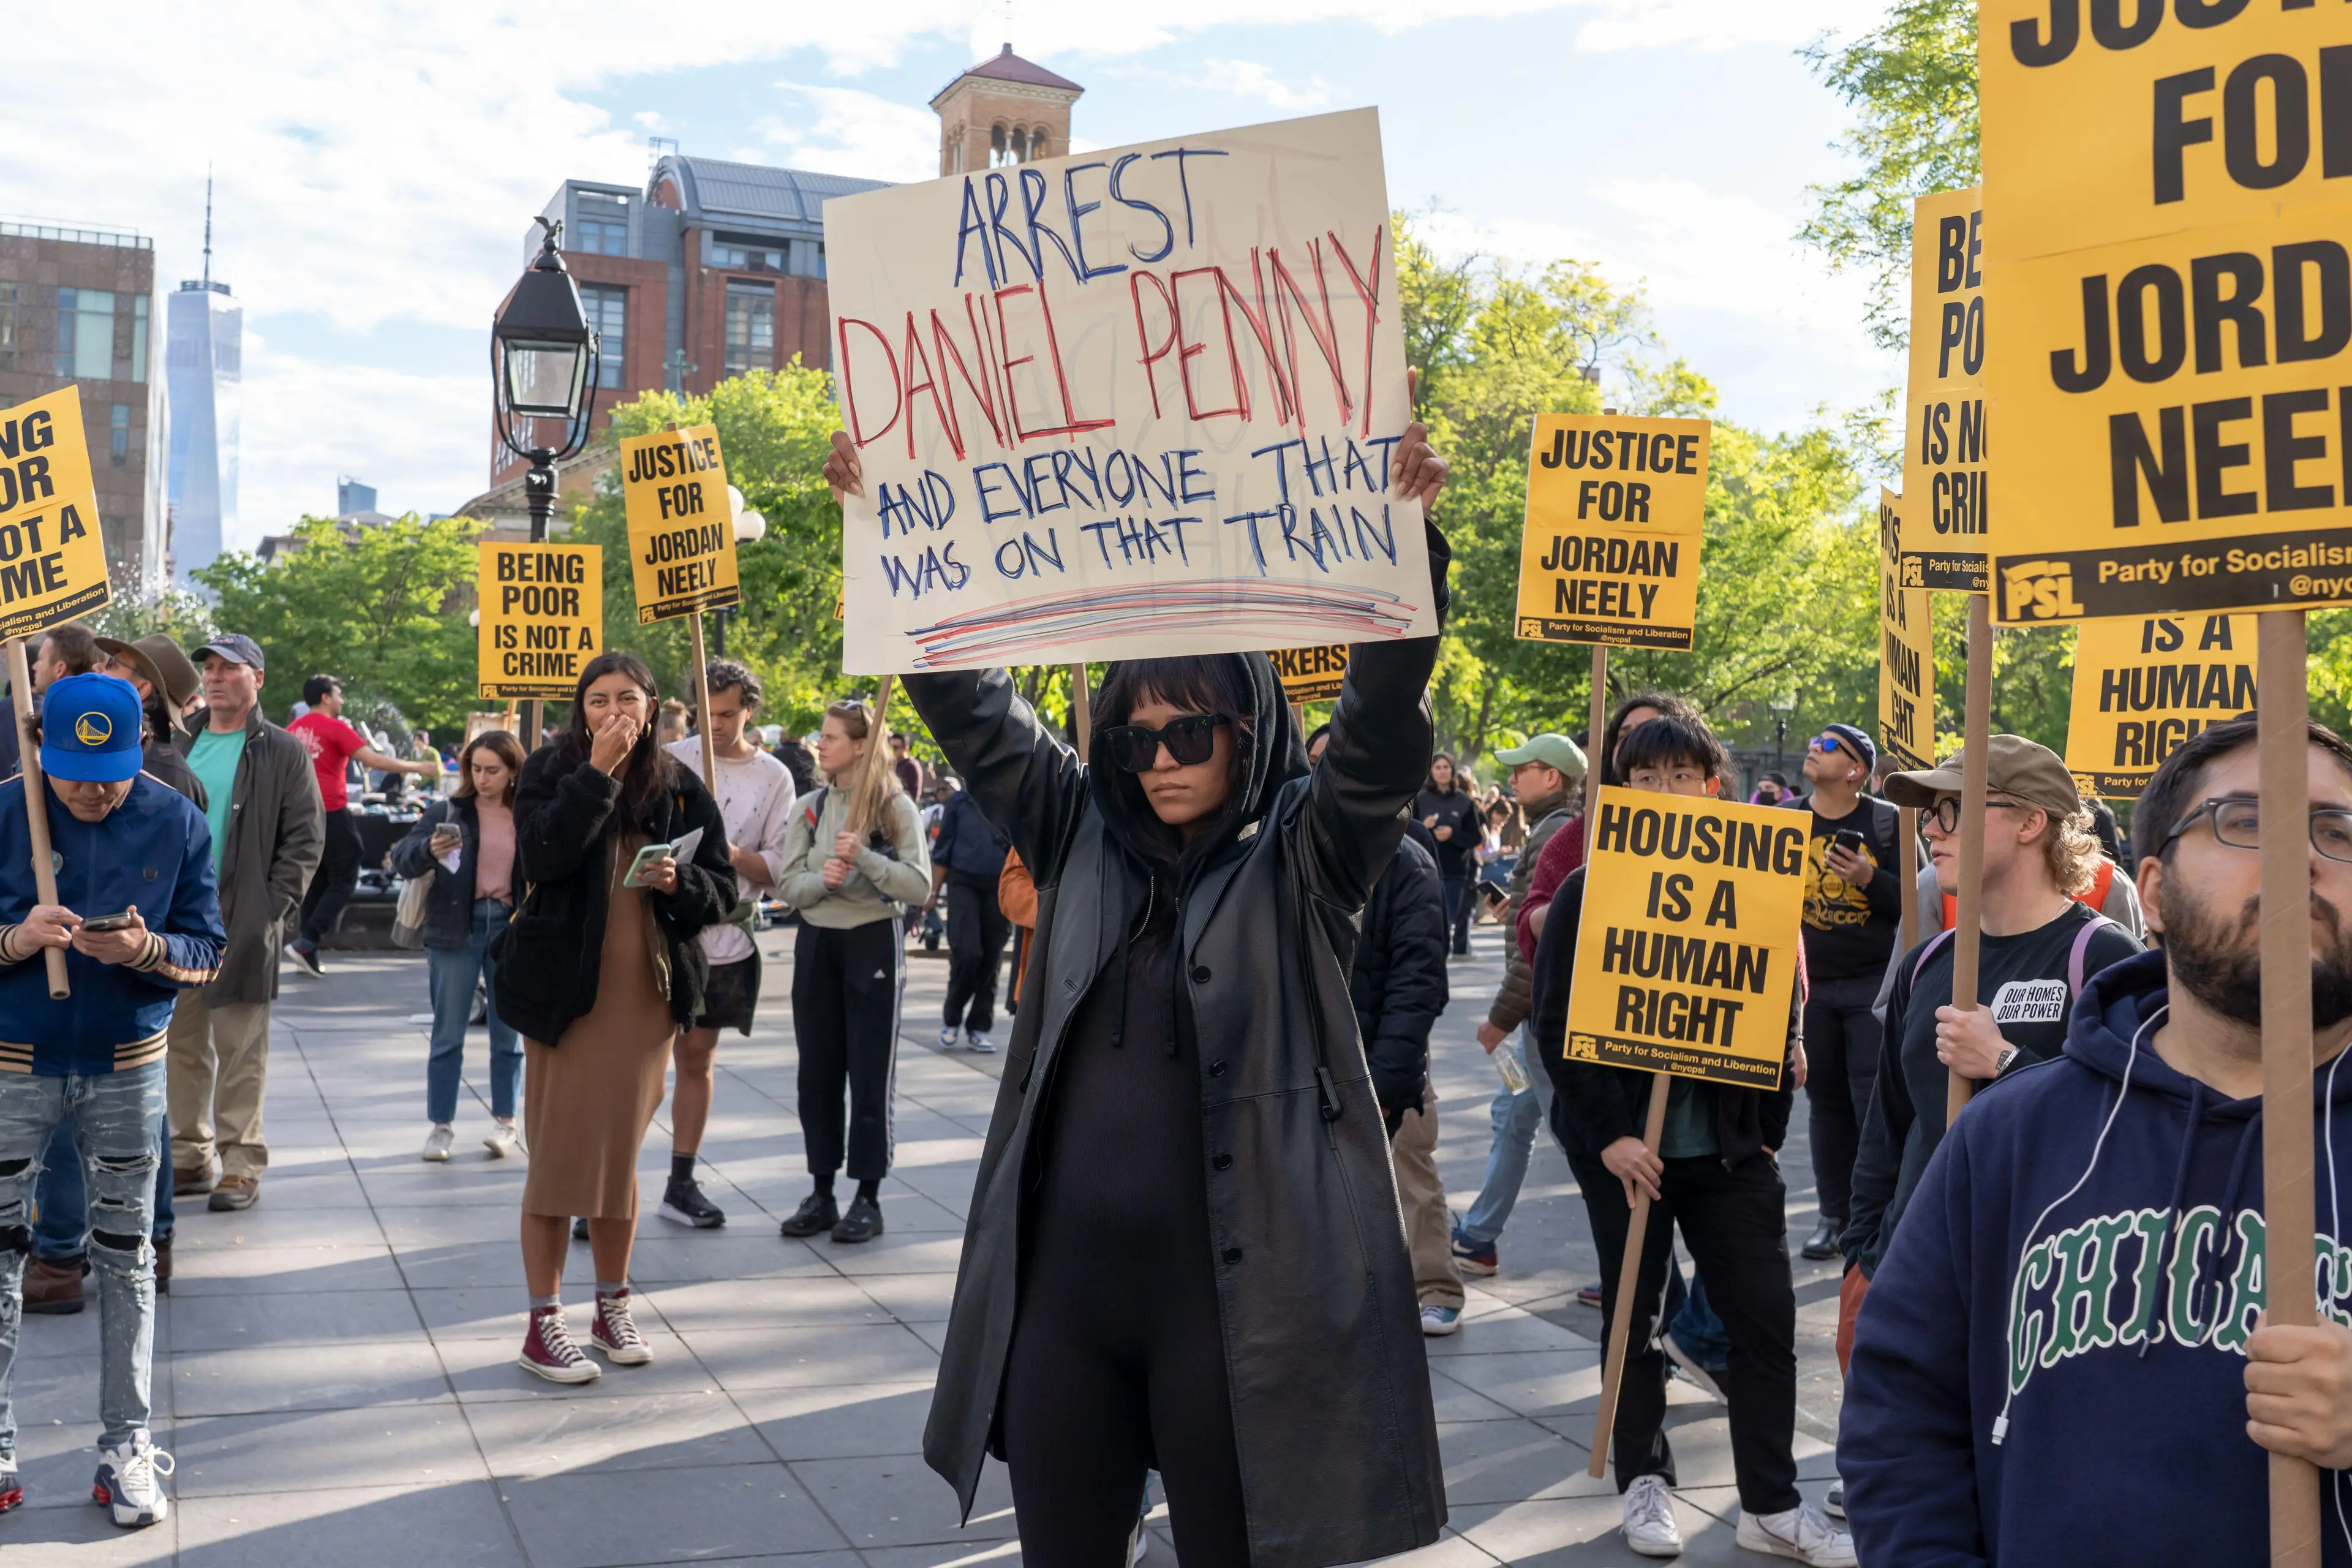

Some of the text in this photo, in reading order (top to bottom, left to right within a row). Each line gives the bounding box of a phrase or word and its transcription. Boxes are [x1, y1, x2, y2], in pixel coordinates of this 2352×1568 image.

[954, 147, 1229, 291] ARREST
[2050, 239, 2351, 394] JORD
[839, 224, 1382, 461] DANIEL PENNY
[1540, 429, 1699, 475] JUSTICE
[1922, 402, 1950, 465] IS
[628, 437, 718, 483] JUSTICE
[2109, 385, 2352, 528] NEE
[658, 481, 704, 519] FOR
[877, 434, 1404, 539] AND EVERYONE THAT
[1577, 480, 1651, 523] FOR
[60, 503, 87, 546] A
[646, 522, 723, 565] JORDAN
[497, 552, 584, 584] BEING
[881, 502, 1396, 600] WAS ON THAT TRAIN
[1541, 535, 1679, 578] JORDAN
[1929, 559, 1951, 573] Party
[1952, 560, 1961, 571] for
[2098, 560, 2173, 584] Party
[2180, 554, 2220, 577] for
[0, 551, 68, 606] ME
[658, 557, 717, 598] NEELY
[1902, 564, 1924, 586] PSL
[35, 607, 55, 620] and
[56, 587, 105, 613] Liberation
[502, 586, 579, 617] POOR
[1555, 578, 1659, 619] NEELY
[1887, 571, 1895, 622] IS
[2006, 575, 2084, 620] PSL
[5, 620, 42, 636] @nycpsl
[495, 624, 594, 650] IS NOT A
[1521, 622, 1544, 638] PSL
[1549, 622, 1688, 639] Party for Socialism and Liberation
[1600, 634, 1630, 644] @nycpsl
[2141, 614, 2233, 654] IS A
[503, 652, 578, 677] CRIME
[1316, 683, 1330, 692] and
[2099, 663, 2258, 712] HUMAN
[2104, 777, 2132, 788] Party
[2135, 777, 2148, 786] for
[1597, 803, 1804, 876] HOUSING
[1646, 872, 1737, 930] IS A
[1602, 926, 1769, 994] HUMAN
[1997, 1003, 2060, 1020] OUR POWER
[2004, 986, 2064, 1003] OUR HOMES
[1615, 985, 1743, 1047] RIGHT
[1570, 1041, 1599, 1060] PSL
[1605, 1041, 1776, 1076] Party for Socialism and Liberation
[1670, 1063, 1706, 1075] @nycpsl
